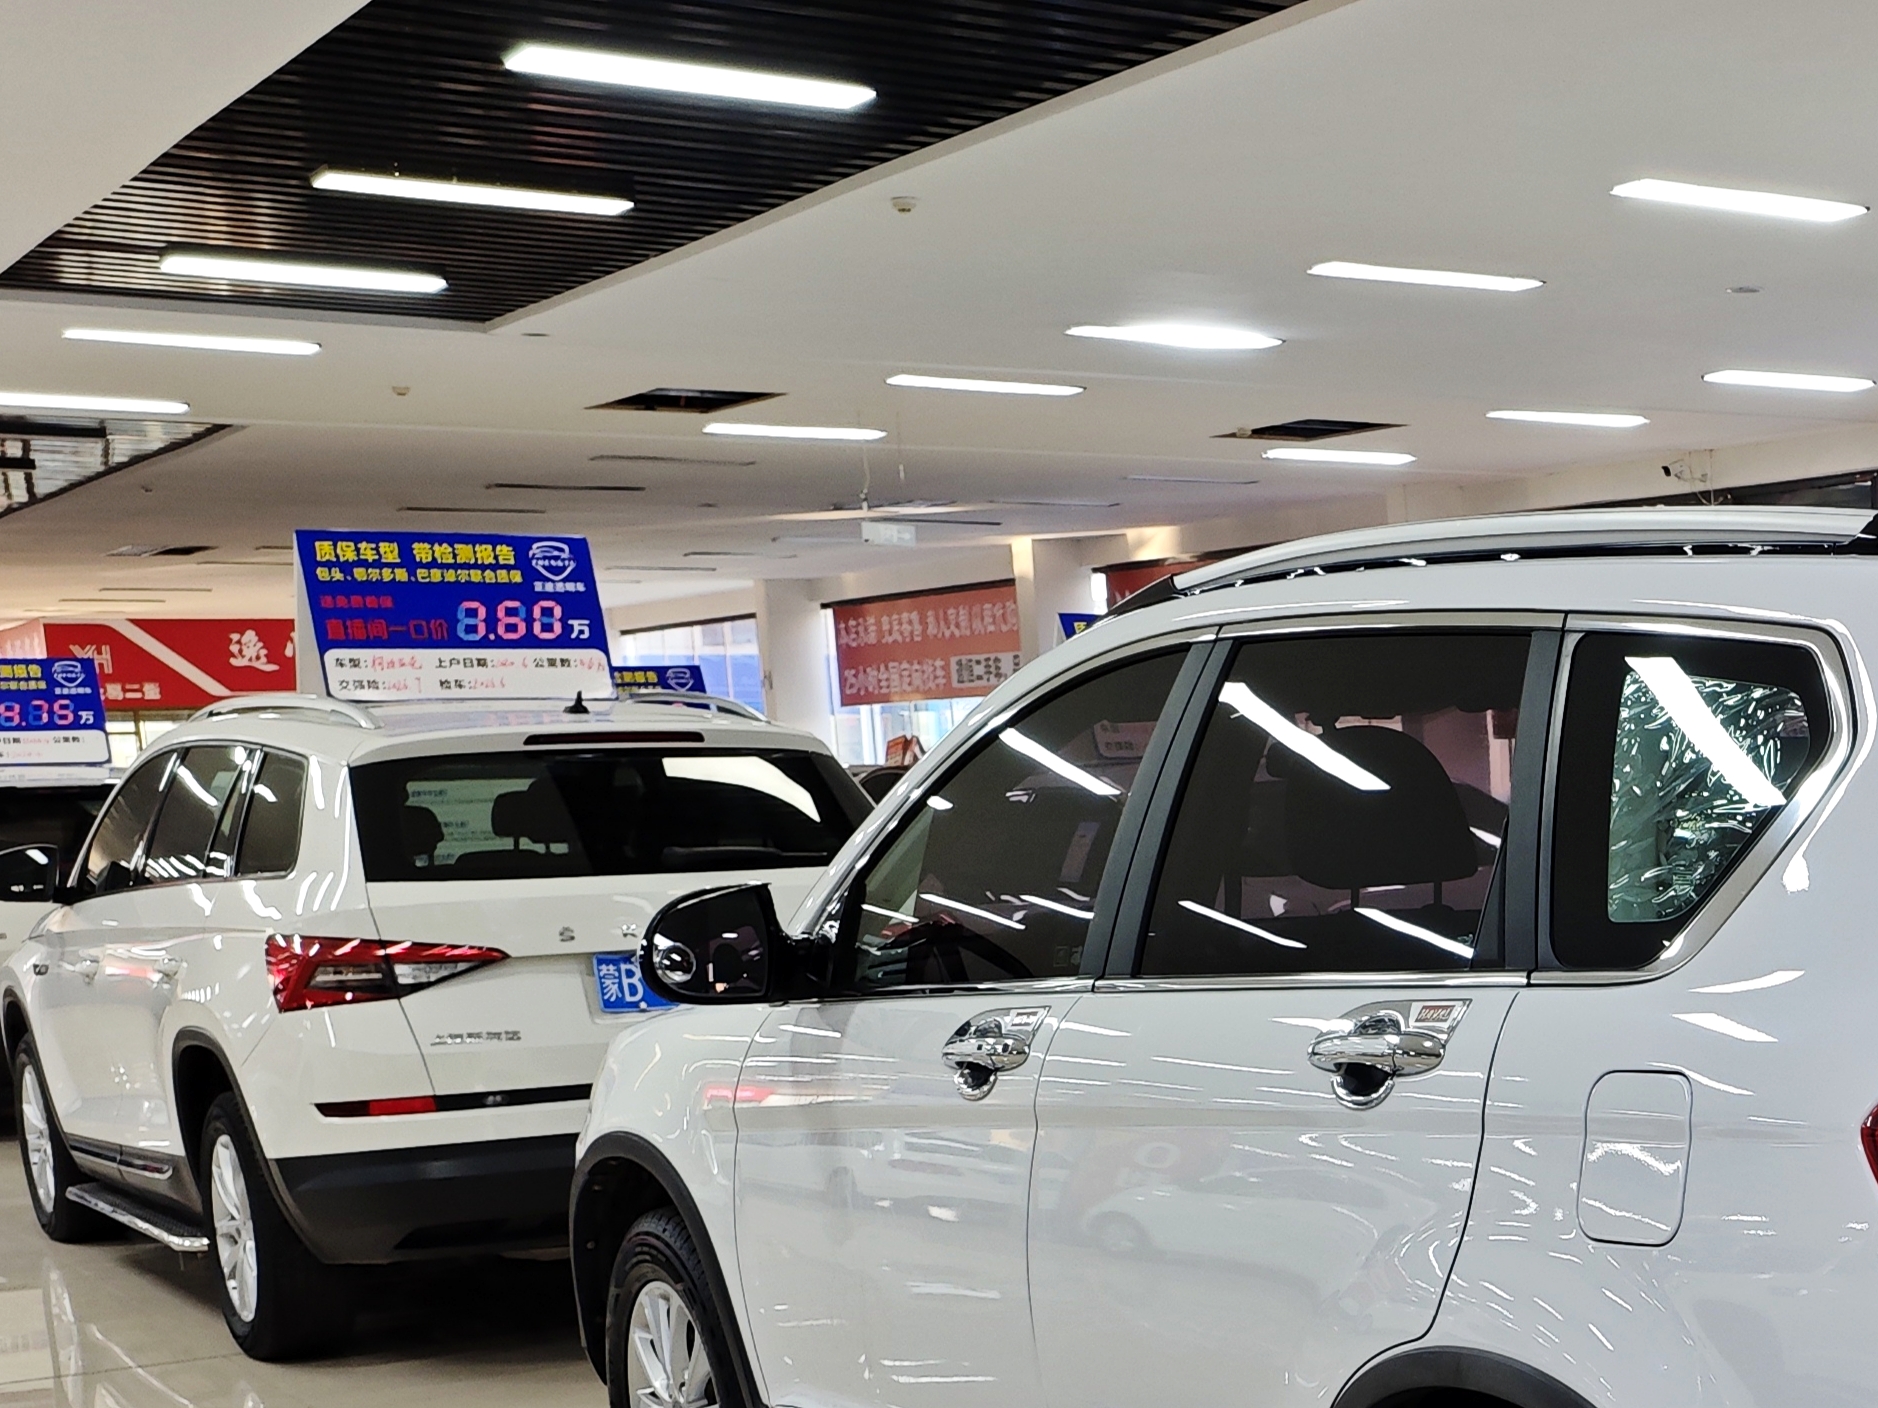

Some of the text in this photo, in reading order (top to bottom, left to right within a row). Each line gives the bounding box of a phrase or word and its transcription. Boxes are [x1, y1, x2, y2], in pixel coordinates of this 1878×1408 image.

[314, 541, 516, 565] 质保车型 带检测报告
[325, 618, 448, 640] 直播间一口价
[567, 619, 591, 640] 万
[77, 711, 95, 725] 万
